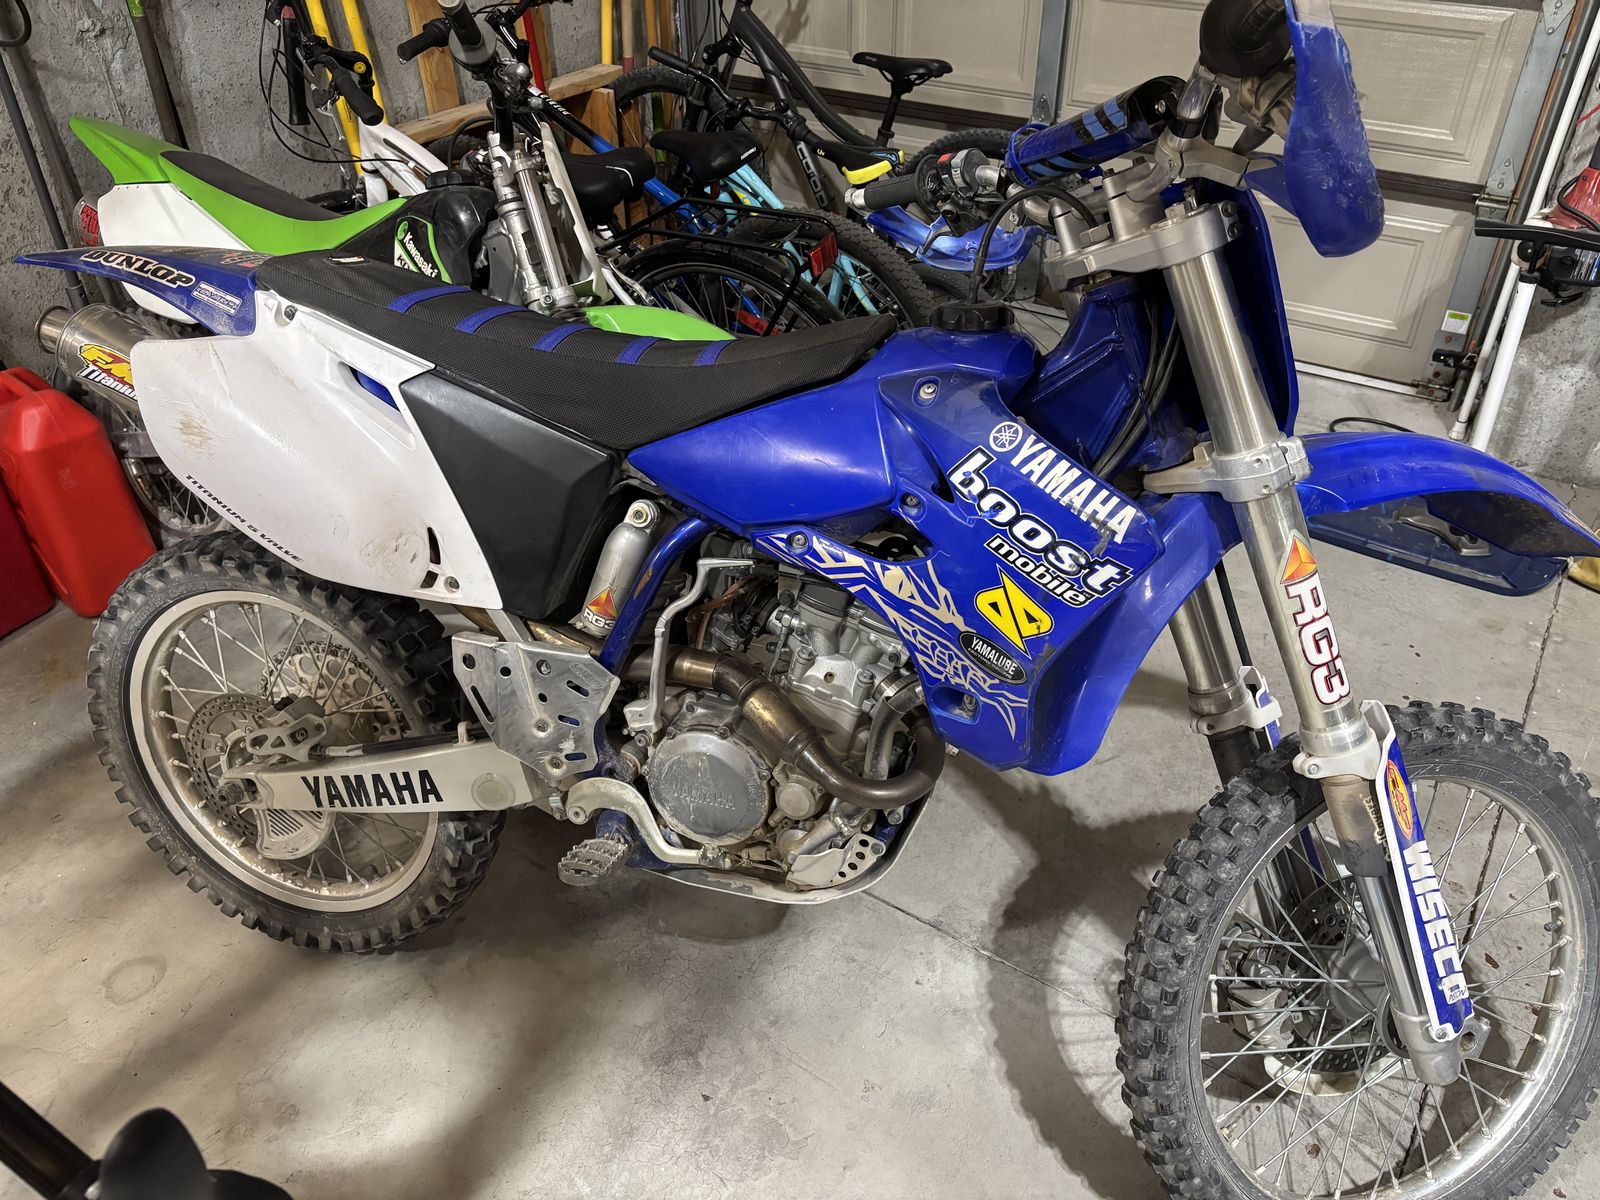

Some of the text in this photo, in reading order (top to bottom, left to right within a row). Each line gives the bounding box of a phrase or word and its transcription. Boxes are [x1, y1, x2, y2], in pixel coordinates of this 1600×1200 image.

[82, 250, 196, 288] DUNLOP
[403, 231, 438, 278] Kawasaki
[80, 346, 133, 384] FM
[186, 474, 246, 523] TITANIUM
[1009, 434, 1138, 544] YAMAHA
[948, 446, 1134, 597] boost
[985, 534, 1089, 607] mobile
[971, 636, 1017, 675] YAMALUBE
[1285, 581, 1350, 705] RG3
[301, 769, 443, 808] YAMAHA
